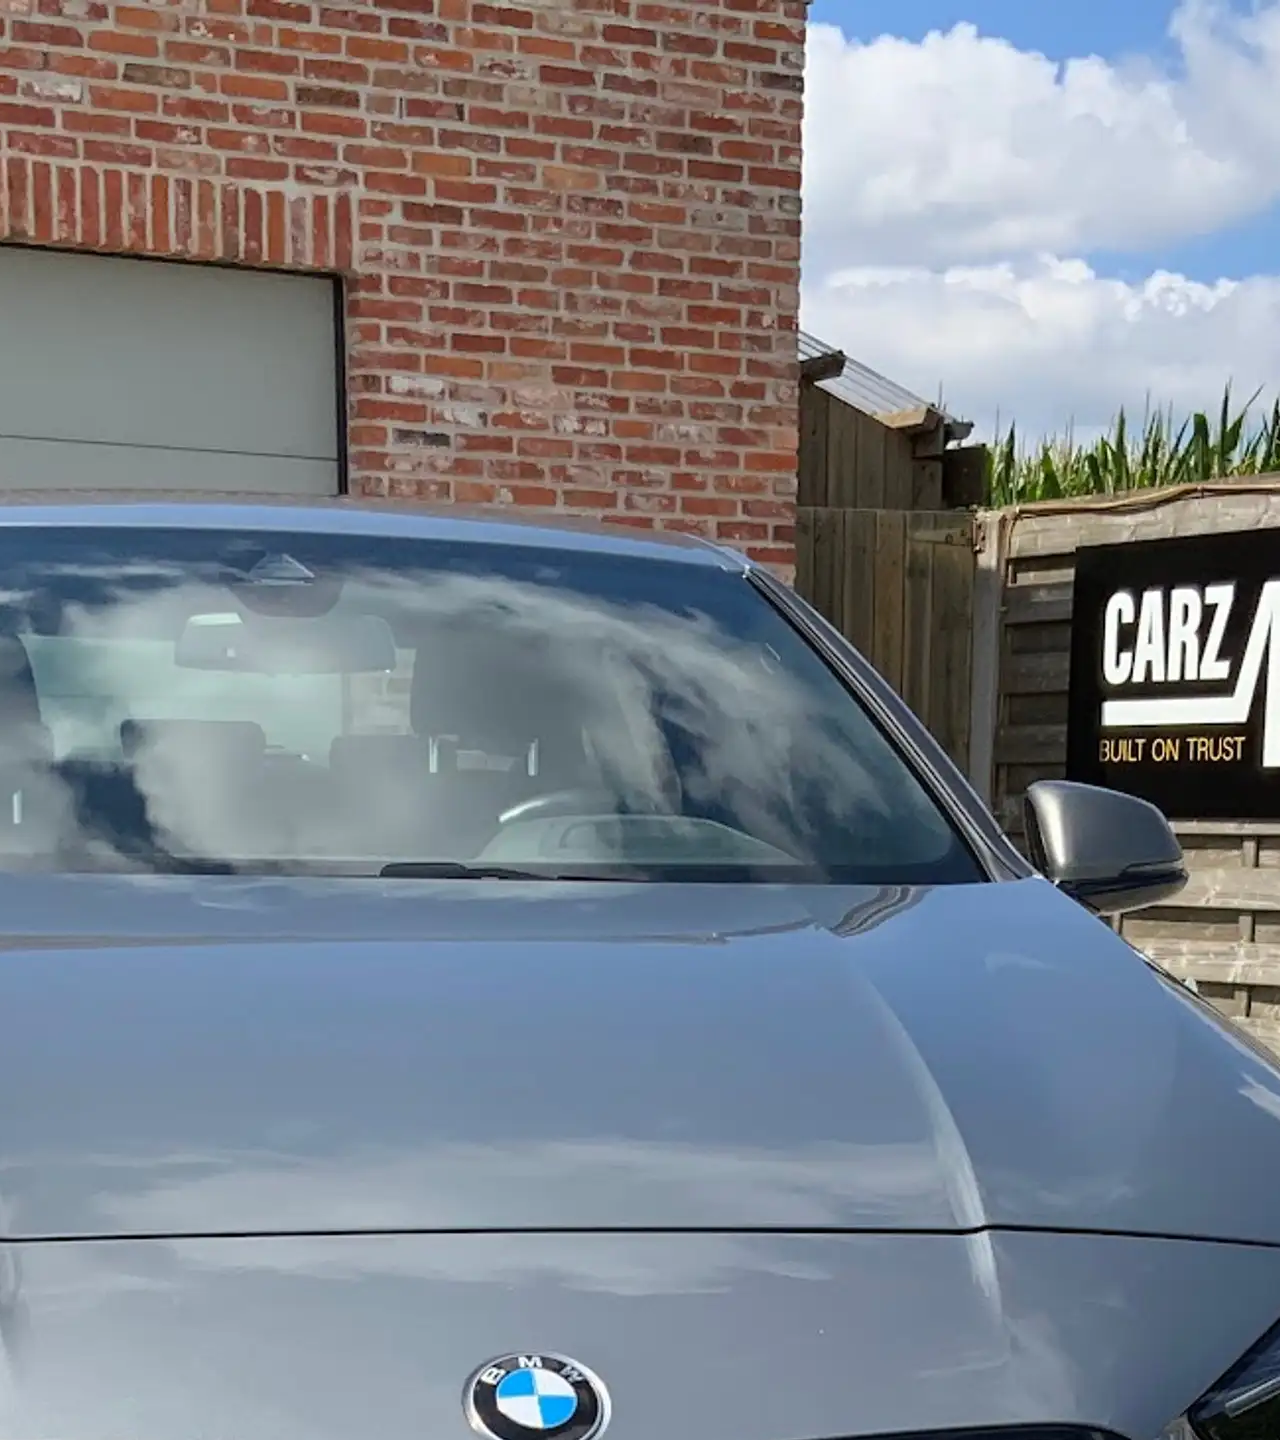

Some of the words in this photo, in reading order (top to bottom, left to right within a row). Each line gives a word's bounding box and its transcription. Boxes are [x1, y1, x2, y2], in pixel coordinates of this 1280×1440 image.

[1098, 738, 1147, 763] BUILT
[1151, 738, 1180, 762] ON
[1185, 736, 1246, 762] TRUST
[480, 1356, 586, 1386] BMW
